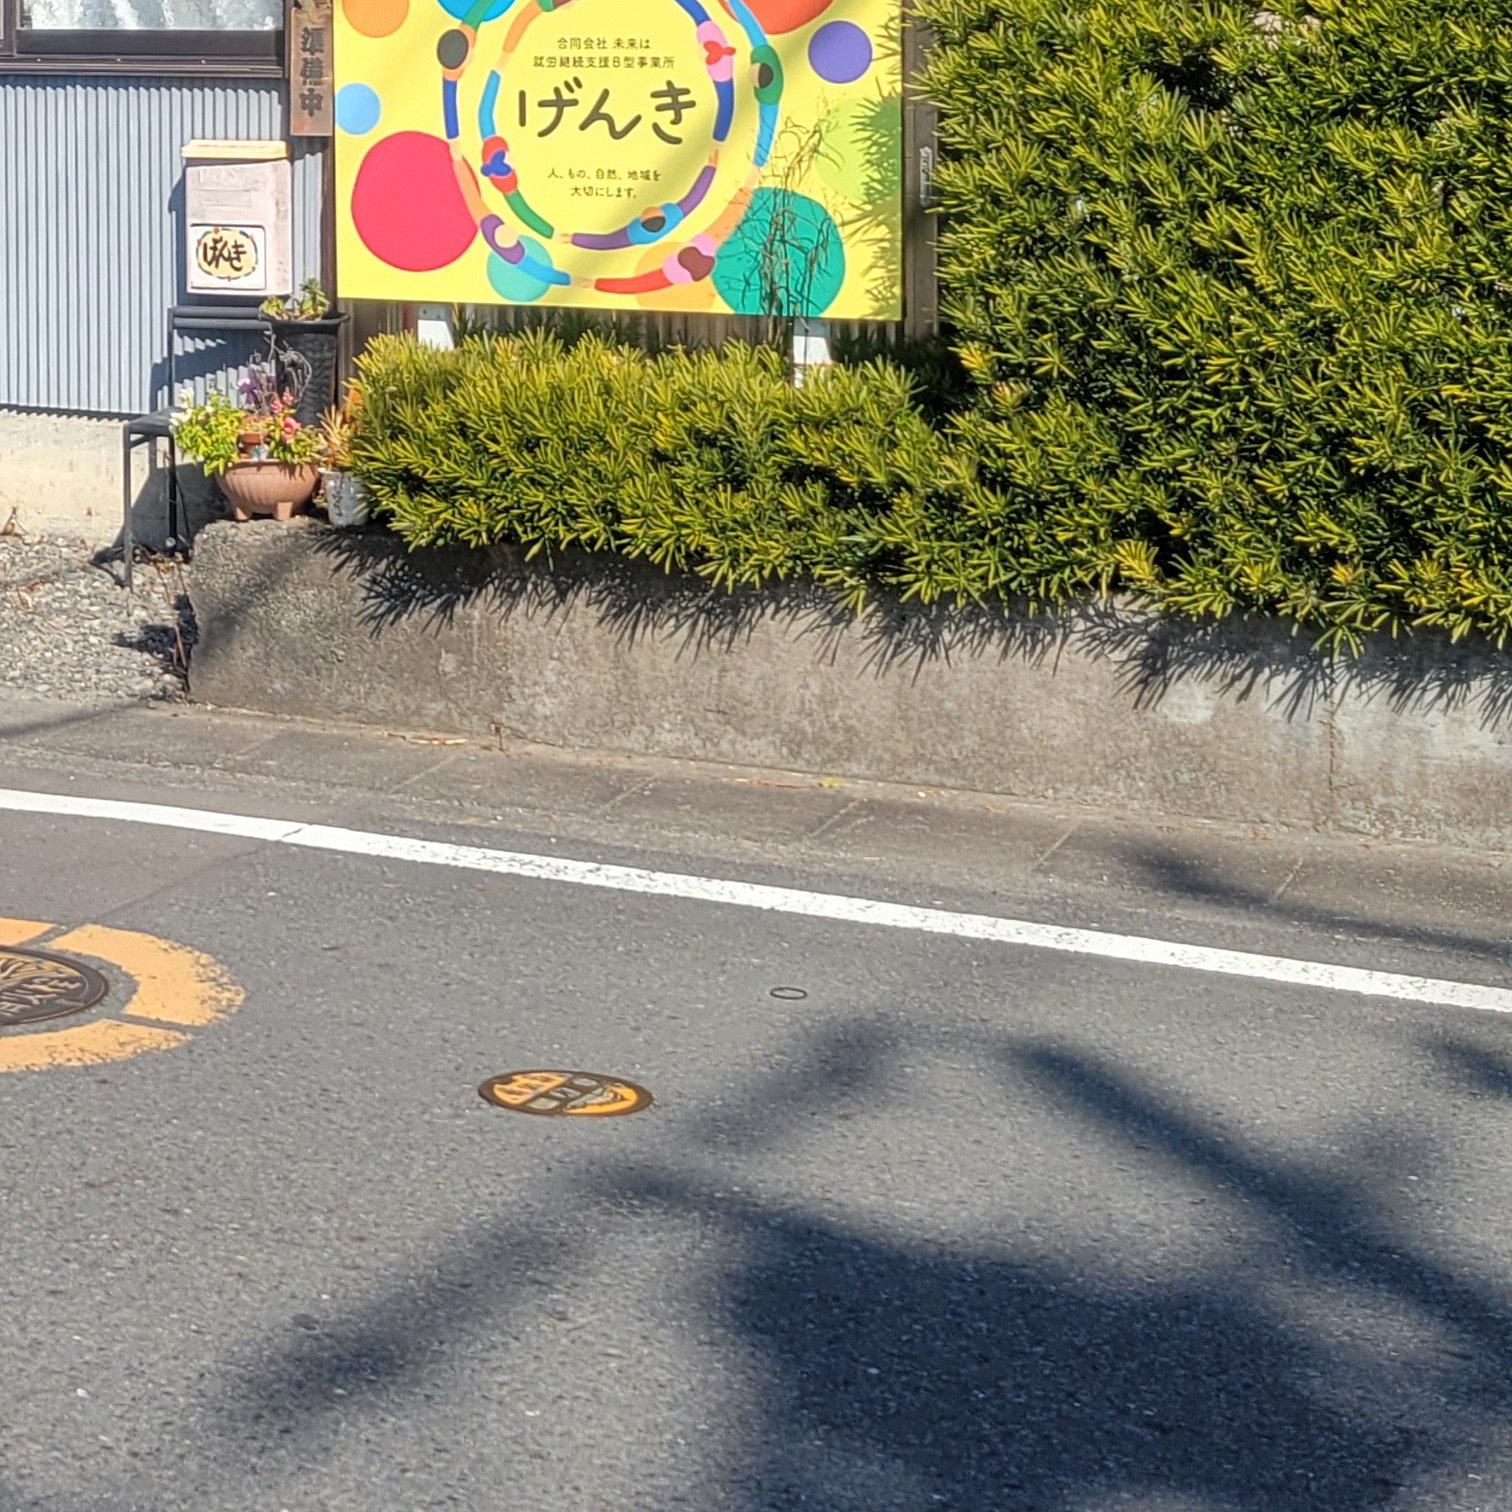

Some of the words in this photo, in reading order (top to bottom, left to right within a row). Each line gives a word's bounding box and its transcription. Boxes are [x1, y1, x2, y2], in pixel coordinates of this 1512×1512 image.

[556, 37, 608, 50] 合同会社
[612, 37, 651, 50] 未来は
[532, 55, 676, 69] 就労継続支援B型事業所
[518, 75, 697, 145] げんき
[202, 235, 247, 272] げんき
